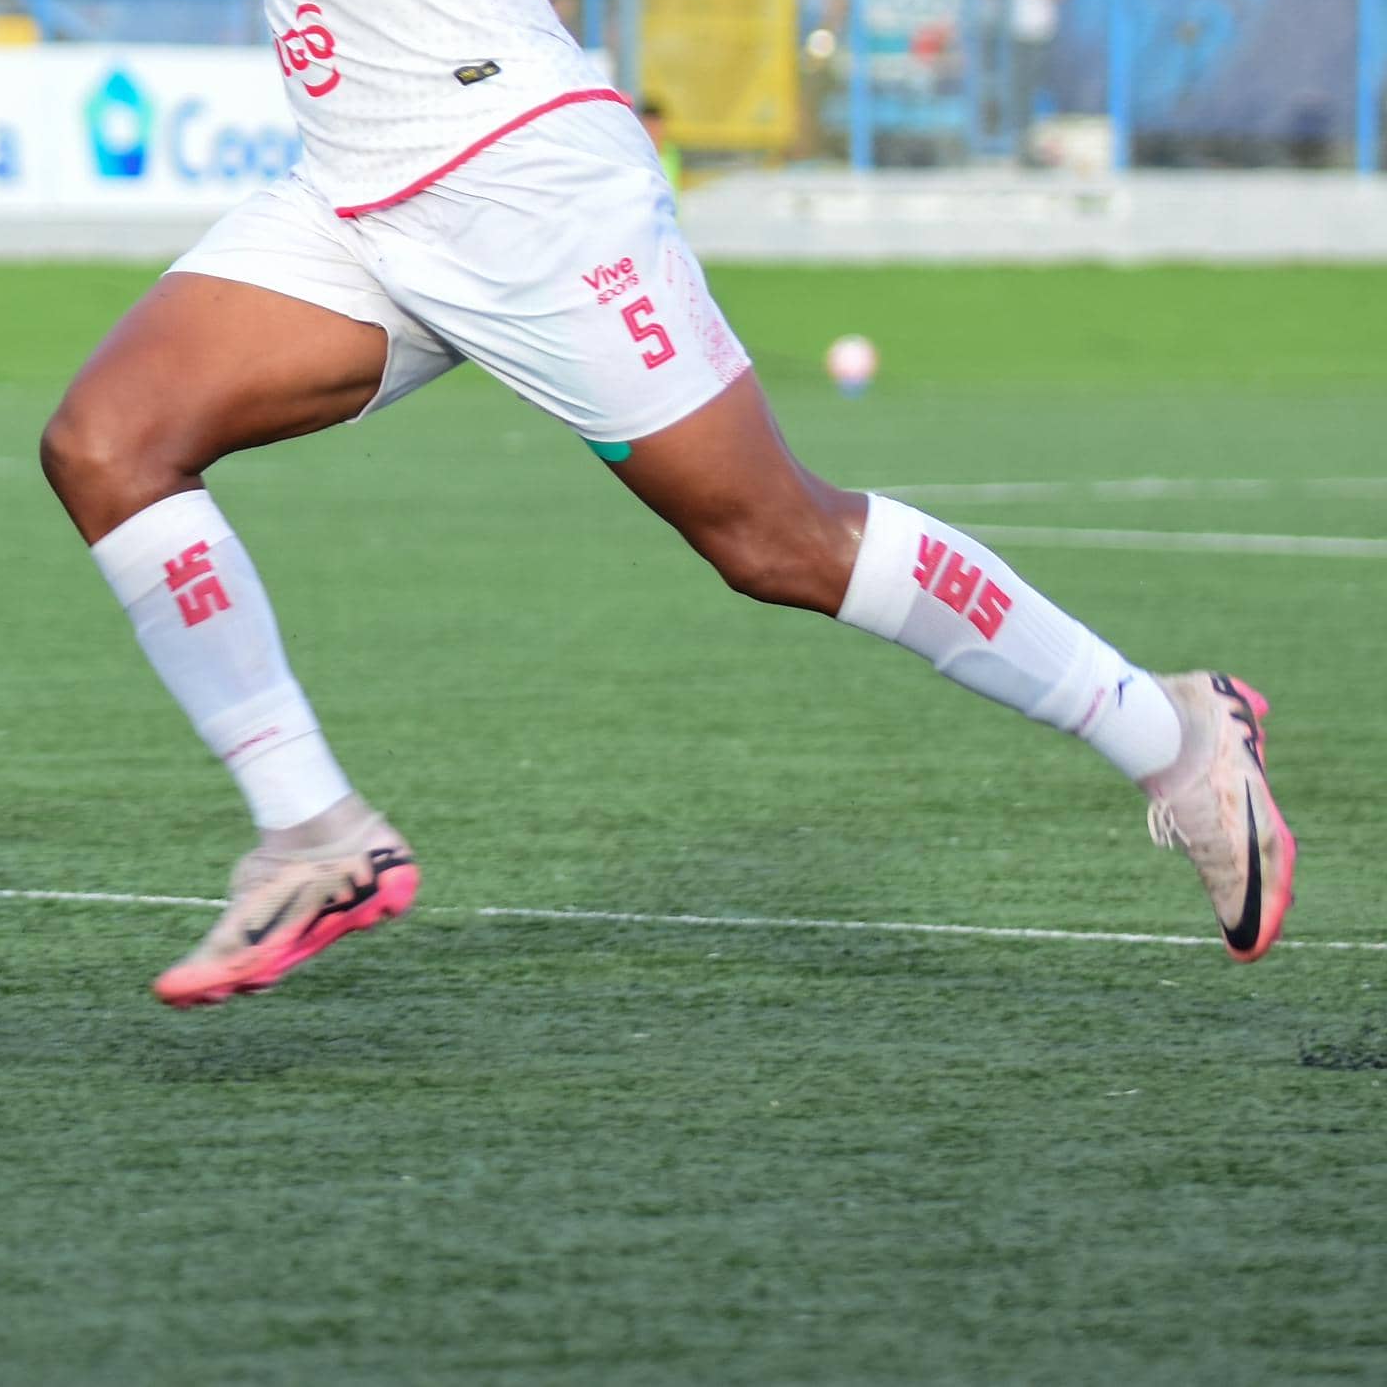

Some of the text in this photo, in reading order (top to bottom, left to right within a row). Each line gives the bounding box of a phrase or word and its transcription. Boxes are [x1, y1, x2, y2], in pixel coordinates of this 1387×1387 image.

[171, 96, 304, 181] Coo
[582, 257, 634, 290] Vive
[621, 295, 677, 370] 5
